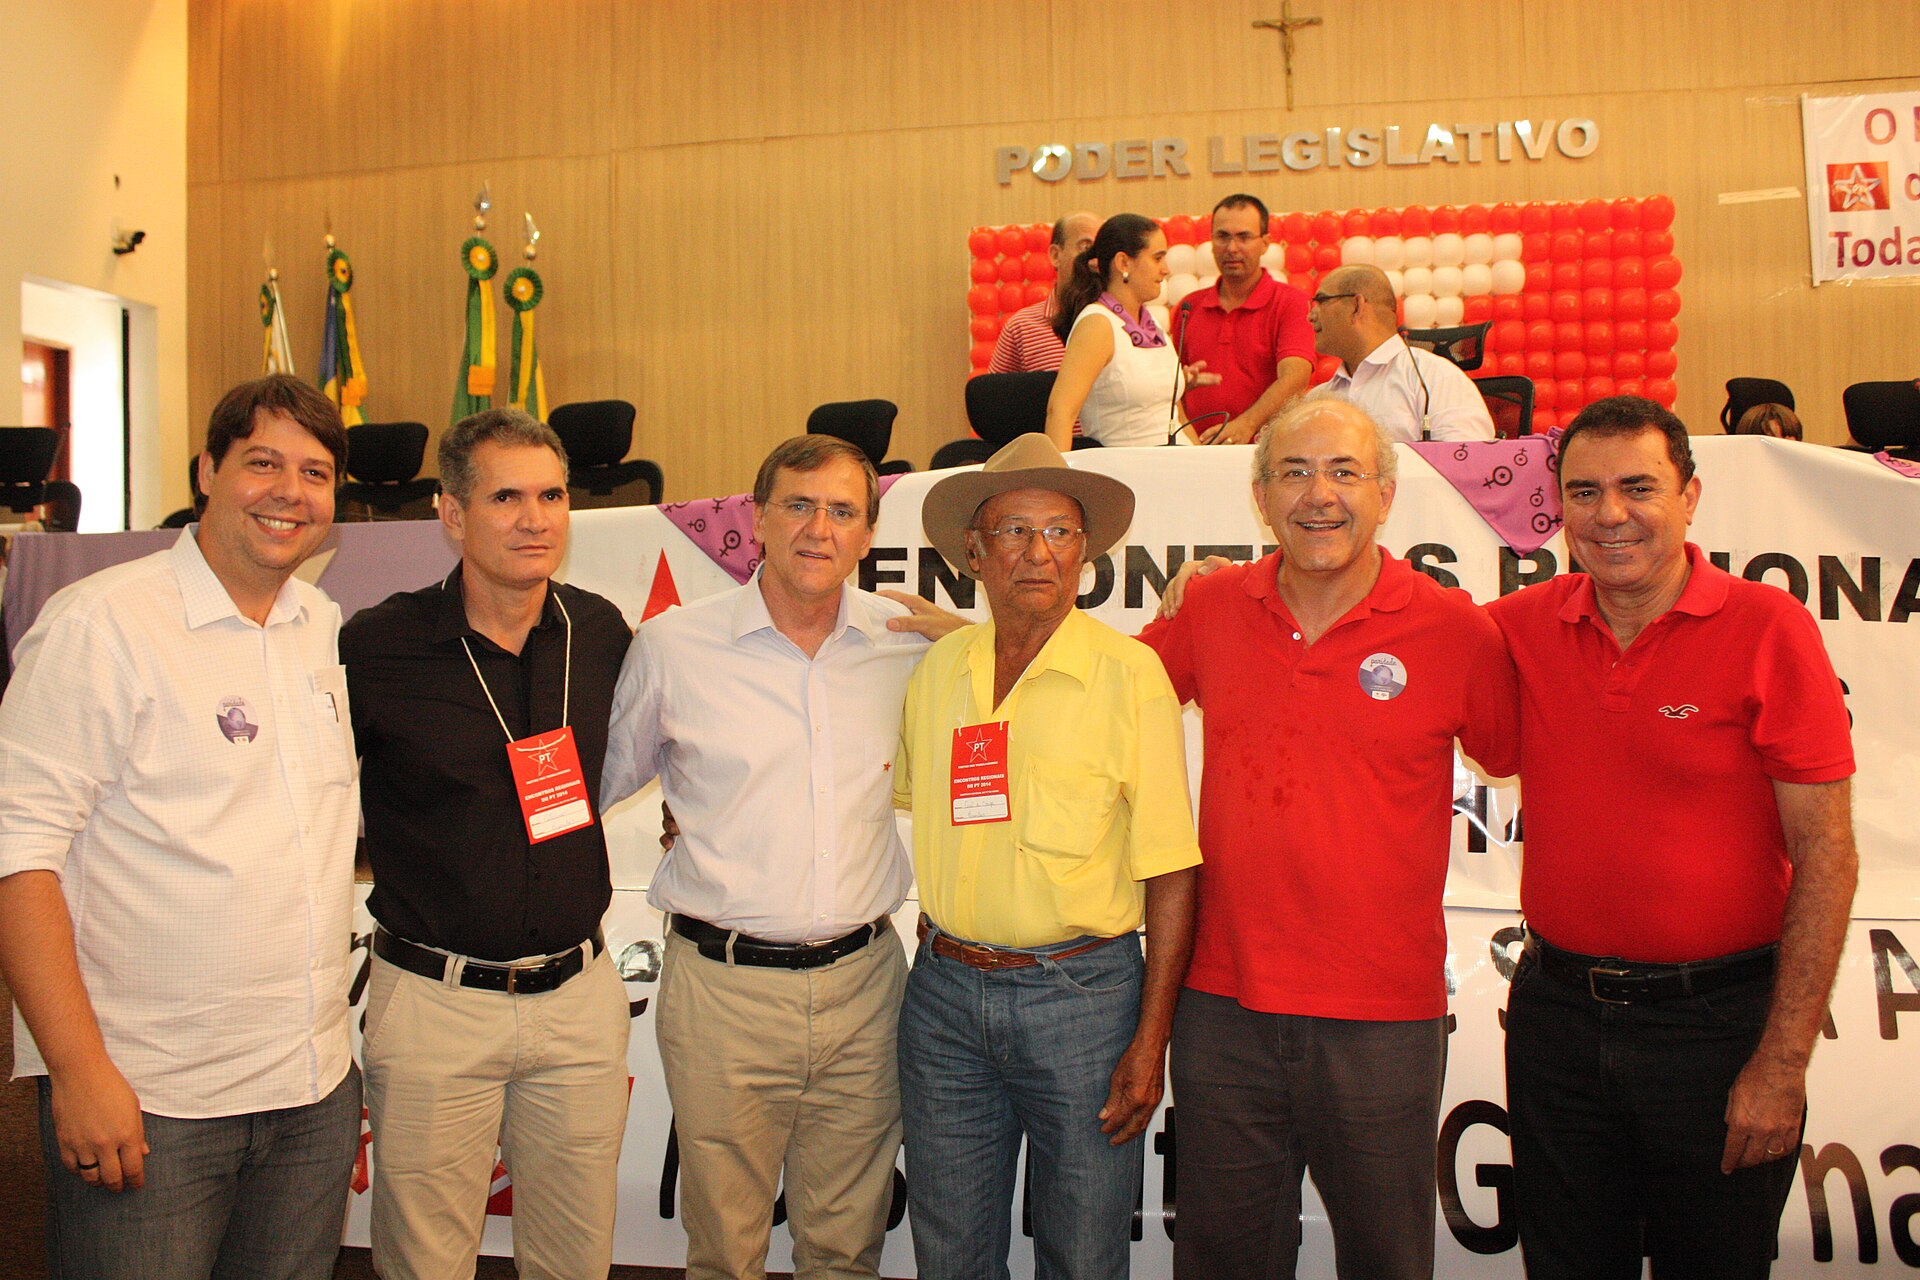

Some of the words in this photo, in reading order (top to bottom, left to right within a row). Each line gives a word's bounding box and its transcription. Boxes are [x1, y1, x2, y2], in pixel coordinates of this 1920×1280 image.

[1864, 108, 1897, 145] O
[997, 136, 1190, 184] PODER
[1210, 117, 1600, 176] LEGISLATIVO
[538, 752, 551, 764] PT
[973, 742, 985, 752] PT
